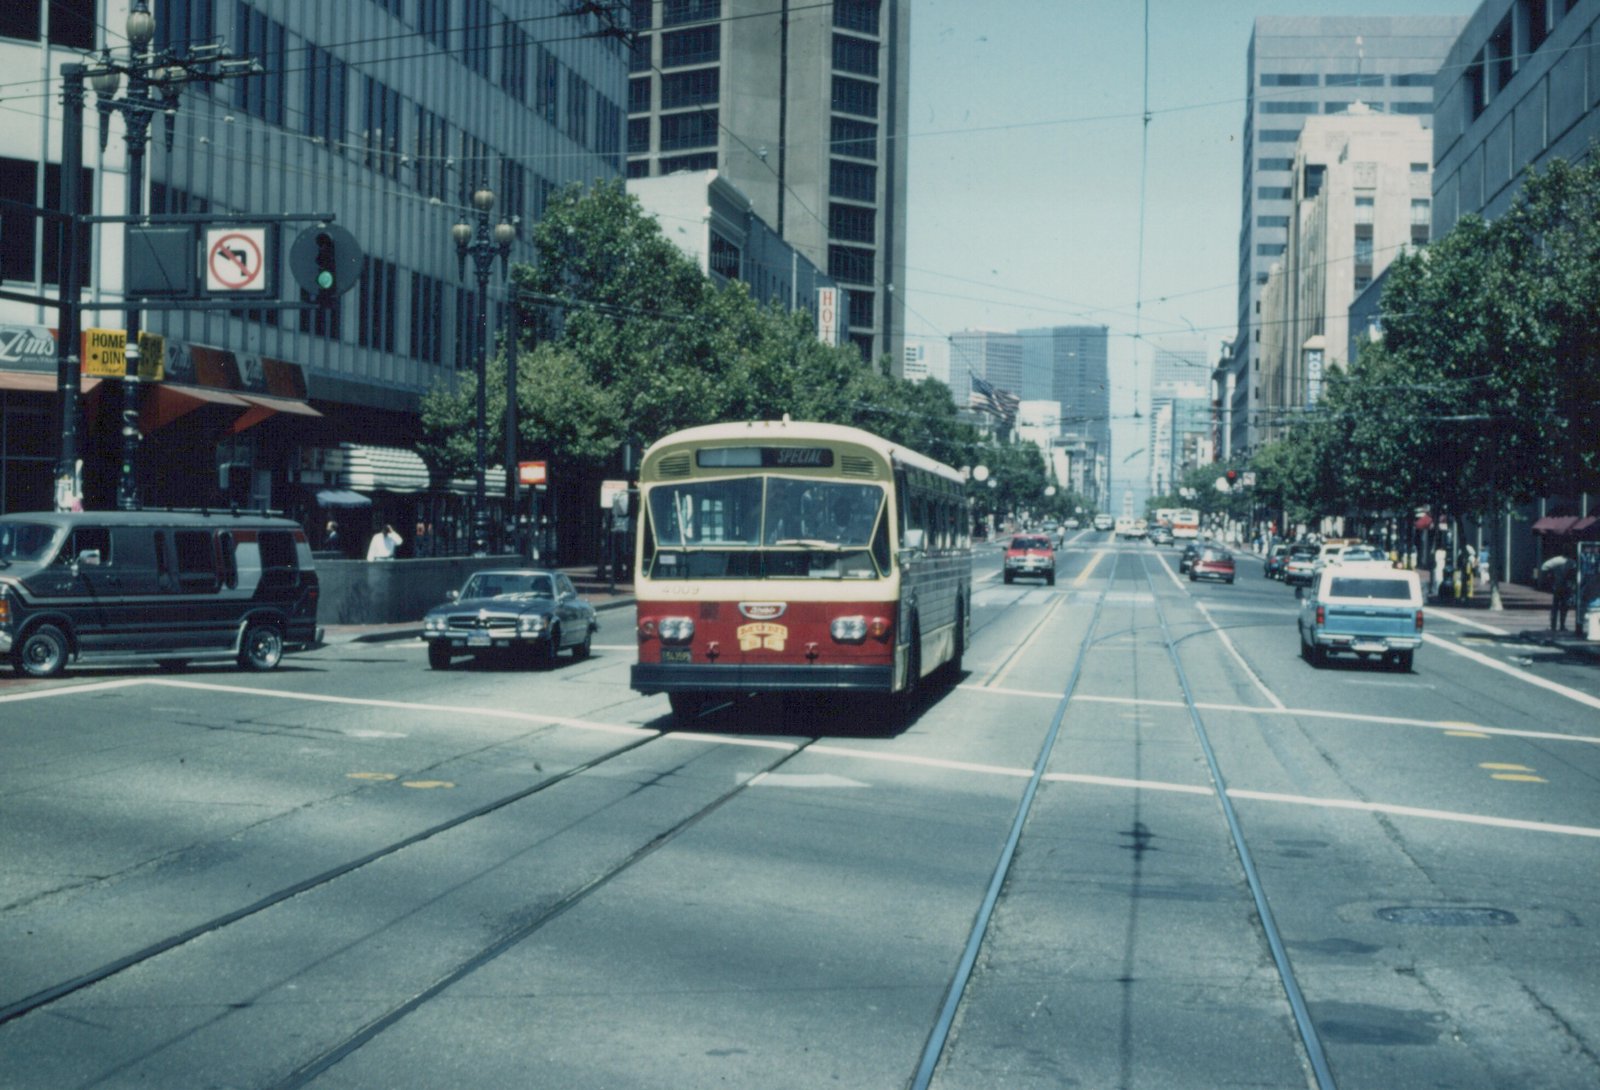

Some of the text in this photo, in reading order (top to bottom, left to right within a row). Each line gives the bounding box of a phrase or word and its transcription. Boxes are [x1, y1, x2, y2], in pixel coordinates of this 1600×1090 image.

[822, 291, 833, 346] HOT
[92, 332, 125, 348] HOME
[777, 448, 821, 464] SPECIAL
